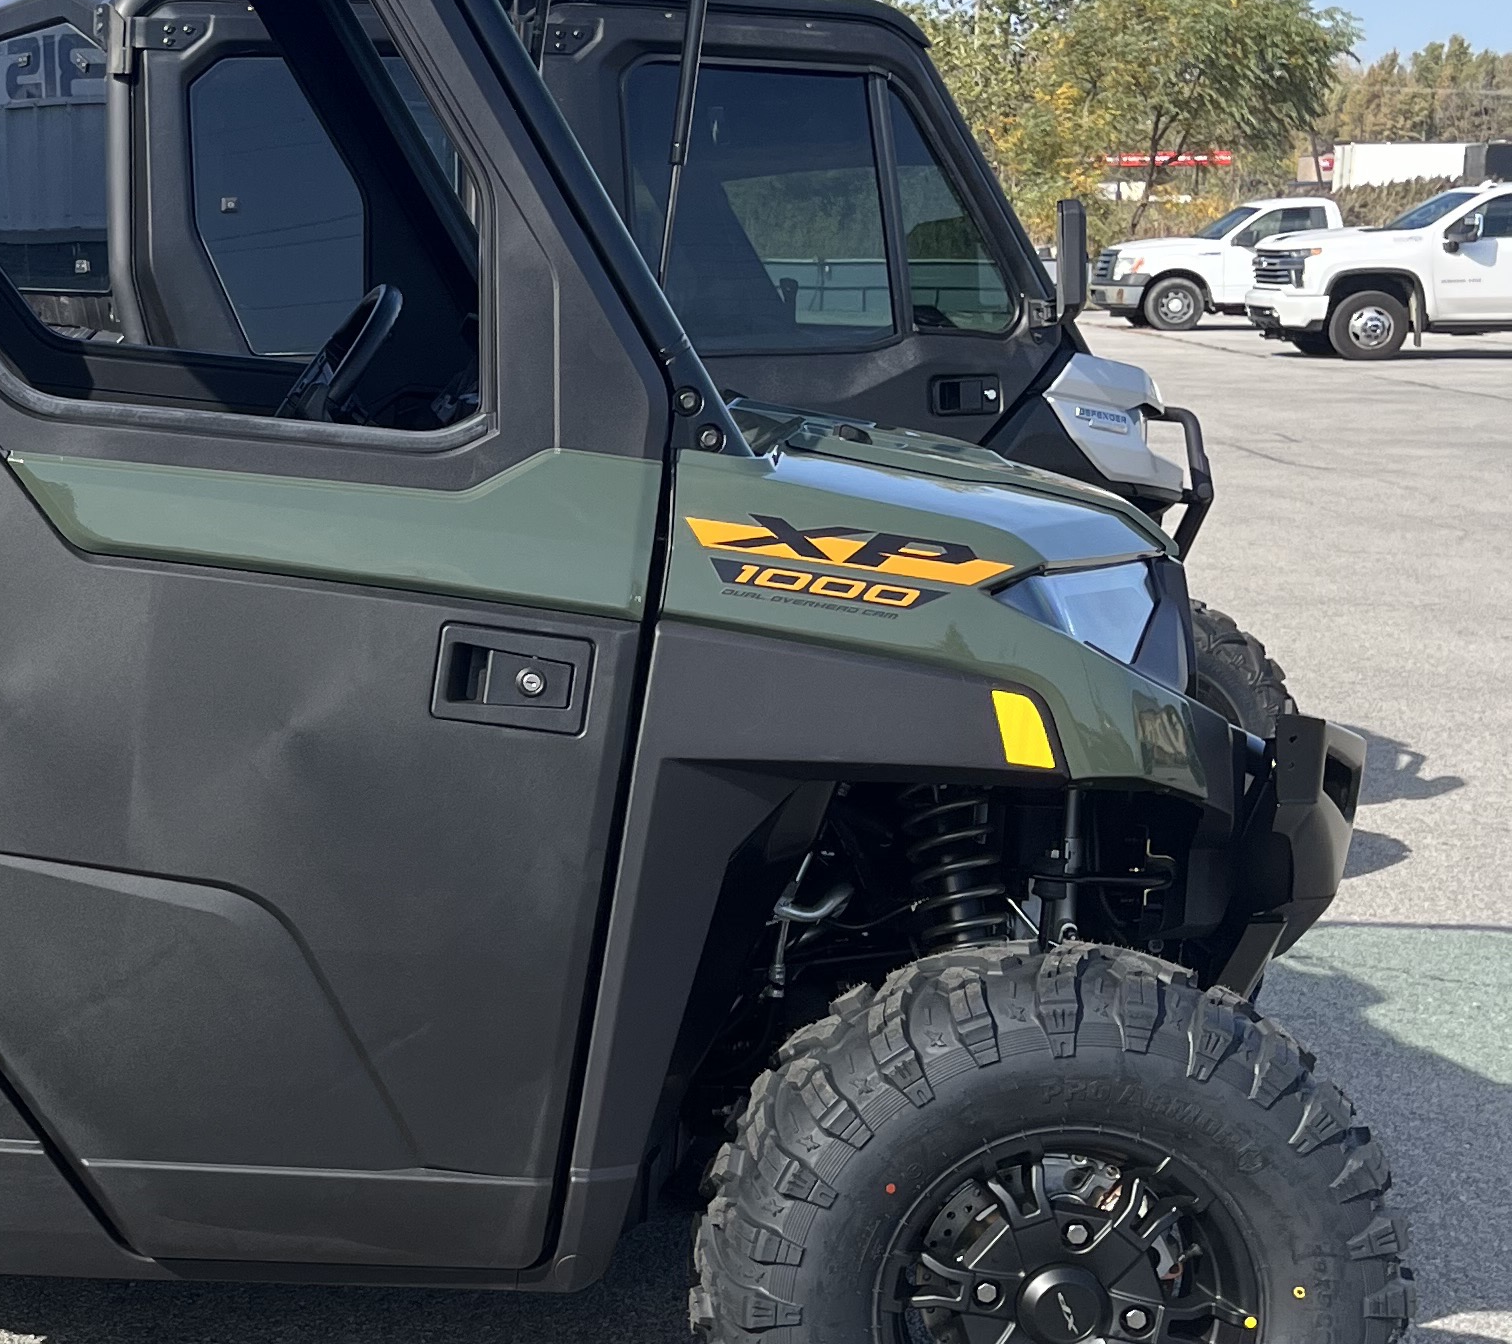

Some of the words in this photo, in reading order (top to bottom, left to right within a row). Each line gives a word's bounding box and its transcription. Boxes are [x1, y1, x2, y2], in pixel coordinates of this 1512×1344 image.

[1079, 406, 1127, 424] DEFENDER
[710, 513, 978, 568] XP
[721, 588, 765, 601] DUAL
[770, 594, 861, 613] OVERHEAD
[861, 608, 900, 620] CAM
[734, 564, 921, 608] 1000
